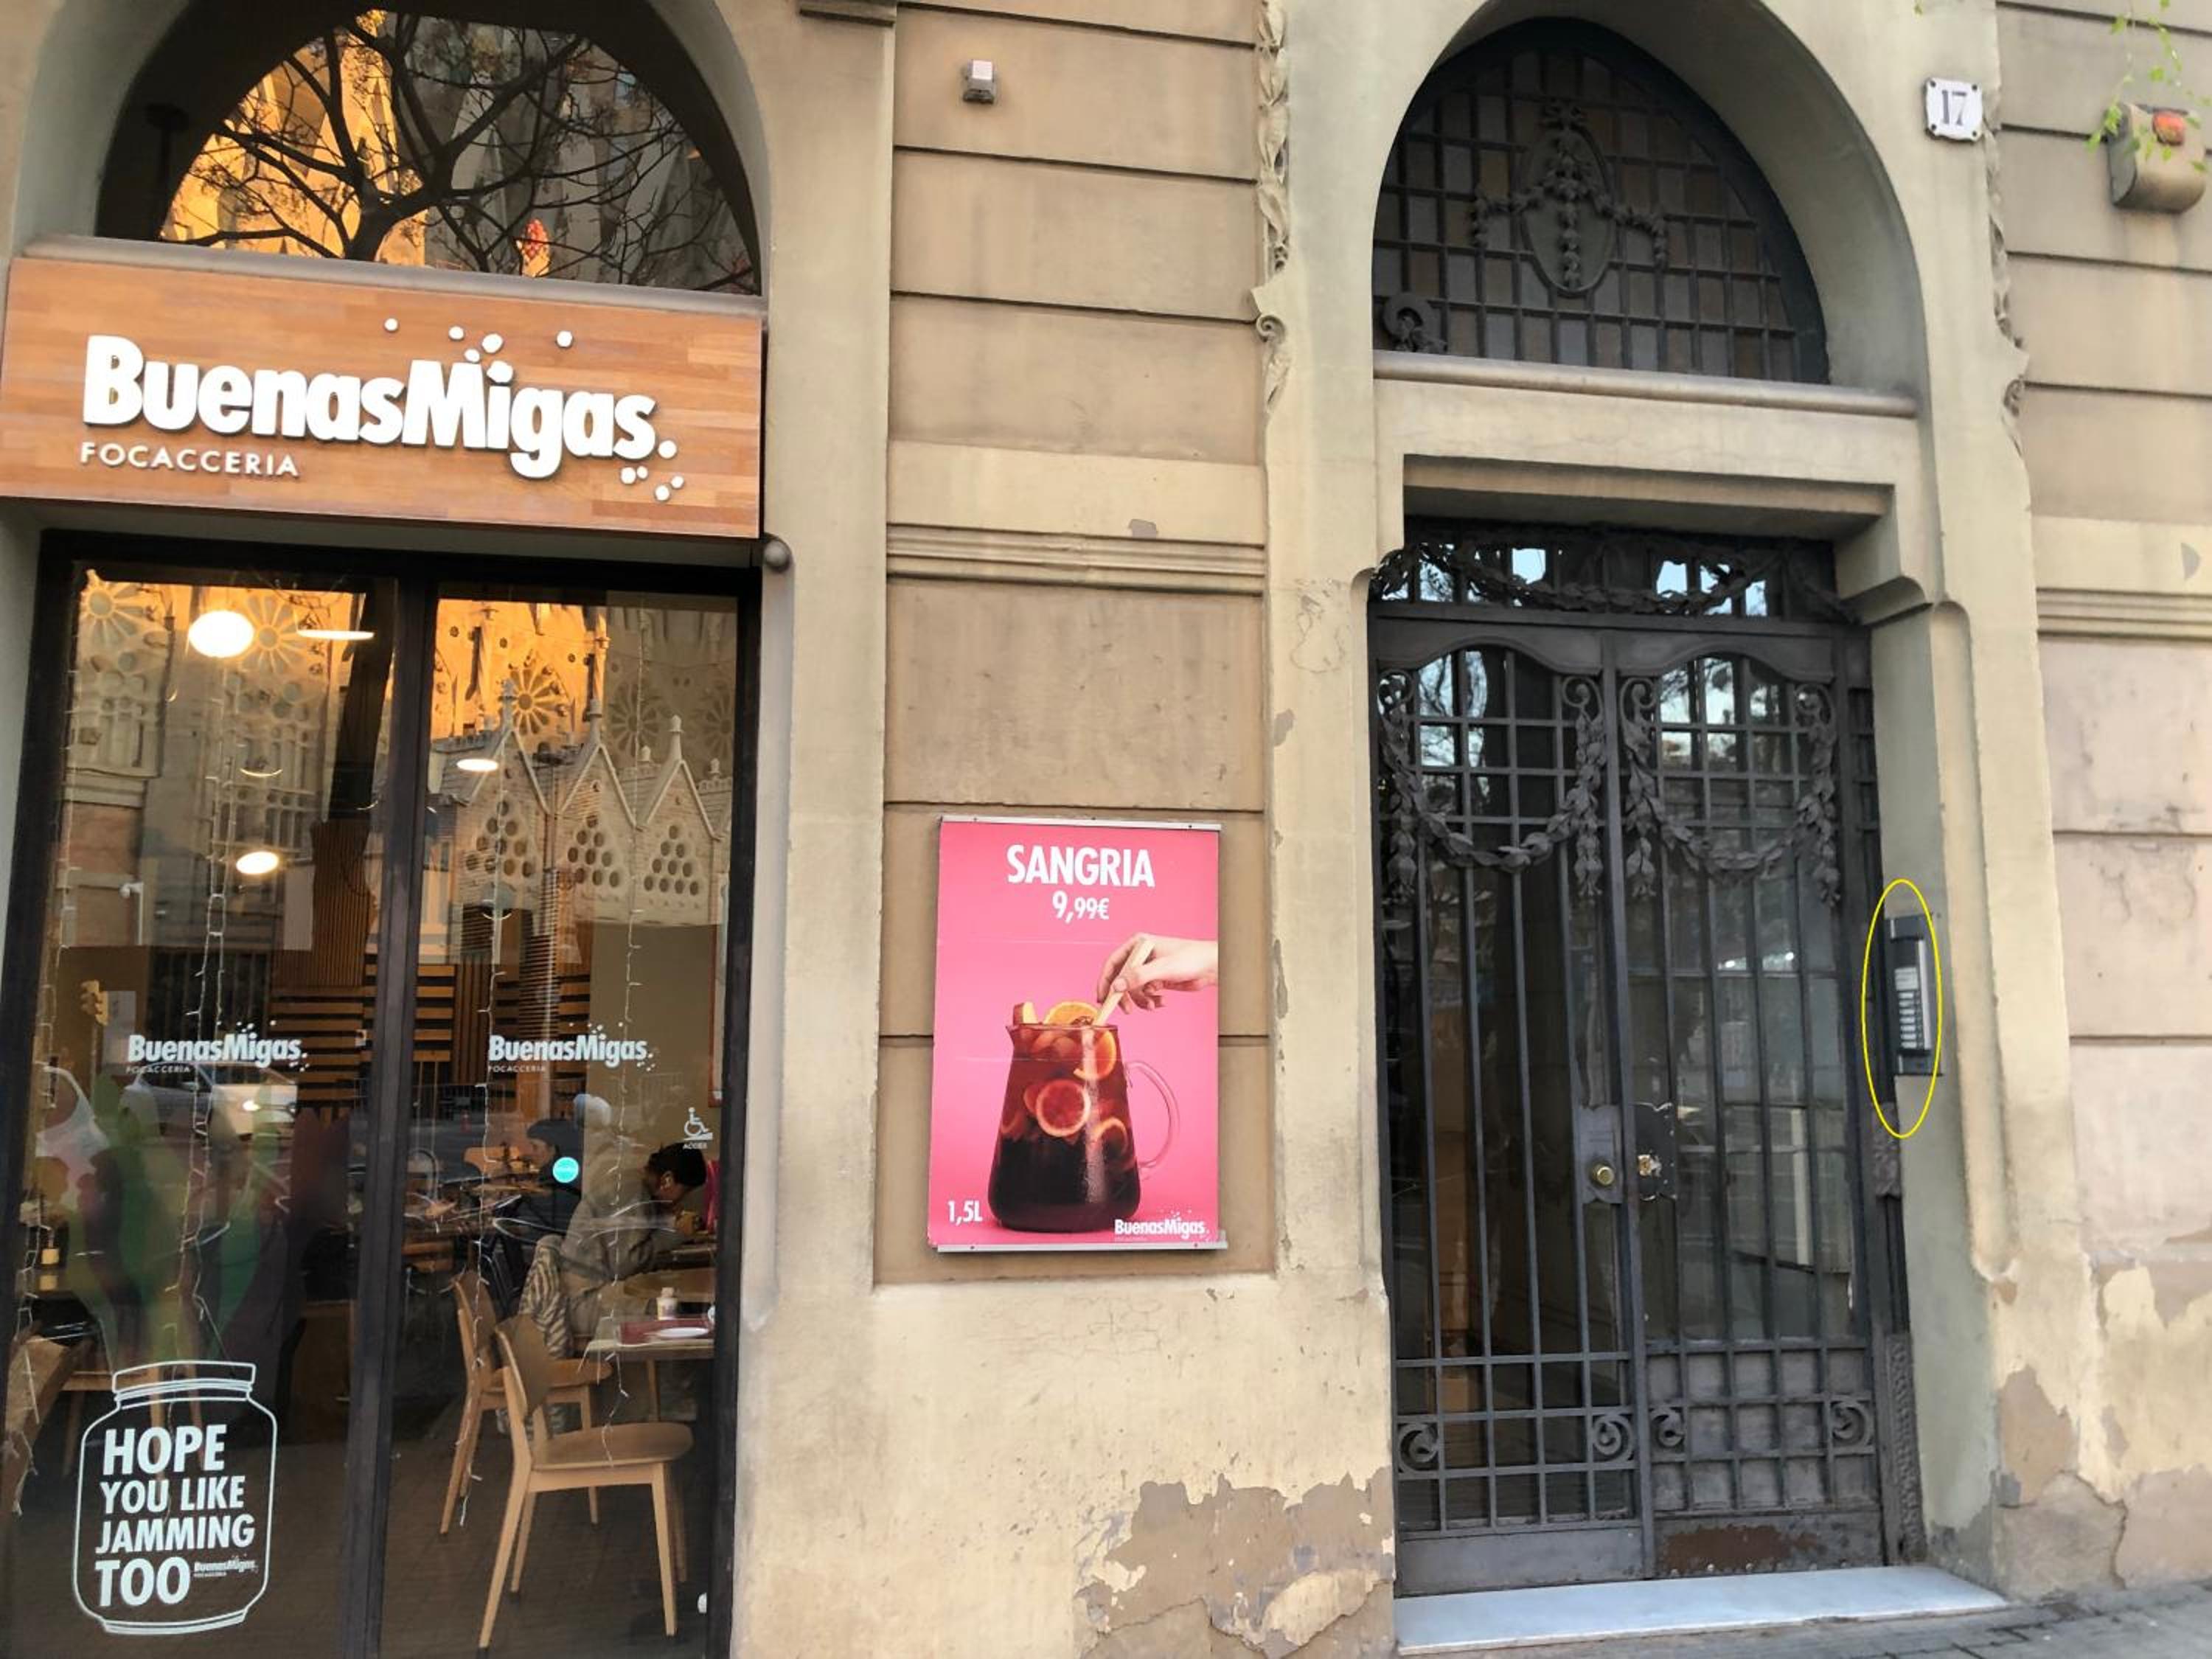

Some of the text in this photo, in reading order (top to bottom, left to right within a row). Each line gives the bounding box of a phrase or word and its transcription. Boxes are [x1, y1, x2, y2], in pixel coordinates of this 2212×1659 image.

[1941, 89, 1967, 125] 17
[80, 442, 299, 477] FOCACCERIA
[1006, 844, 1155, 887] SANGRIA
[1052, 890, 1109, 923] 9,99€
[948, 1200, 983, 1225] 1,5L
[103, 1425, 226, 1475] HOPE
[100, 1475, 246, 1514] YOU LIKE
[95, 1514, 255, 1554] JAMMING
[94, 1557, 191, 1607] TOO
